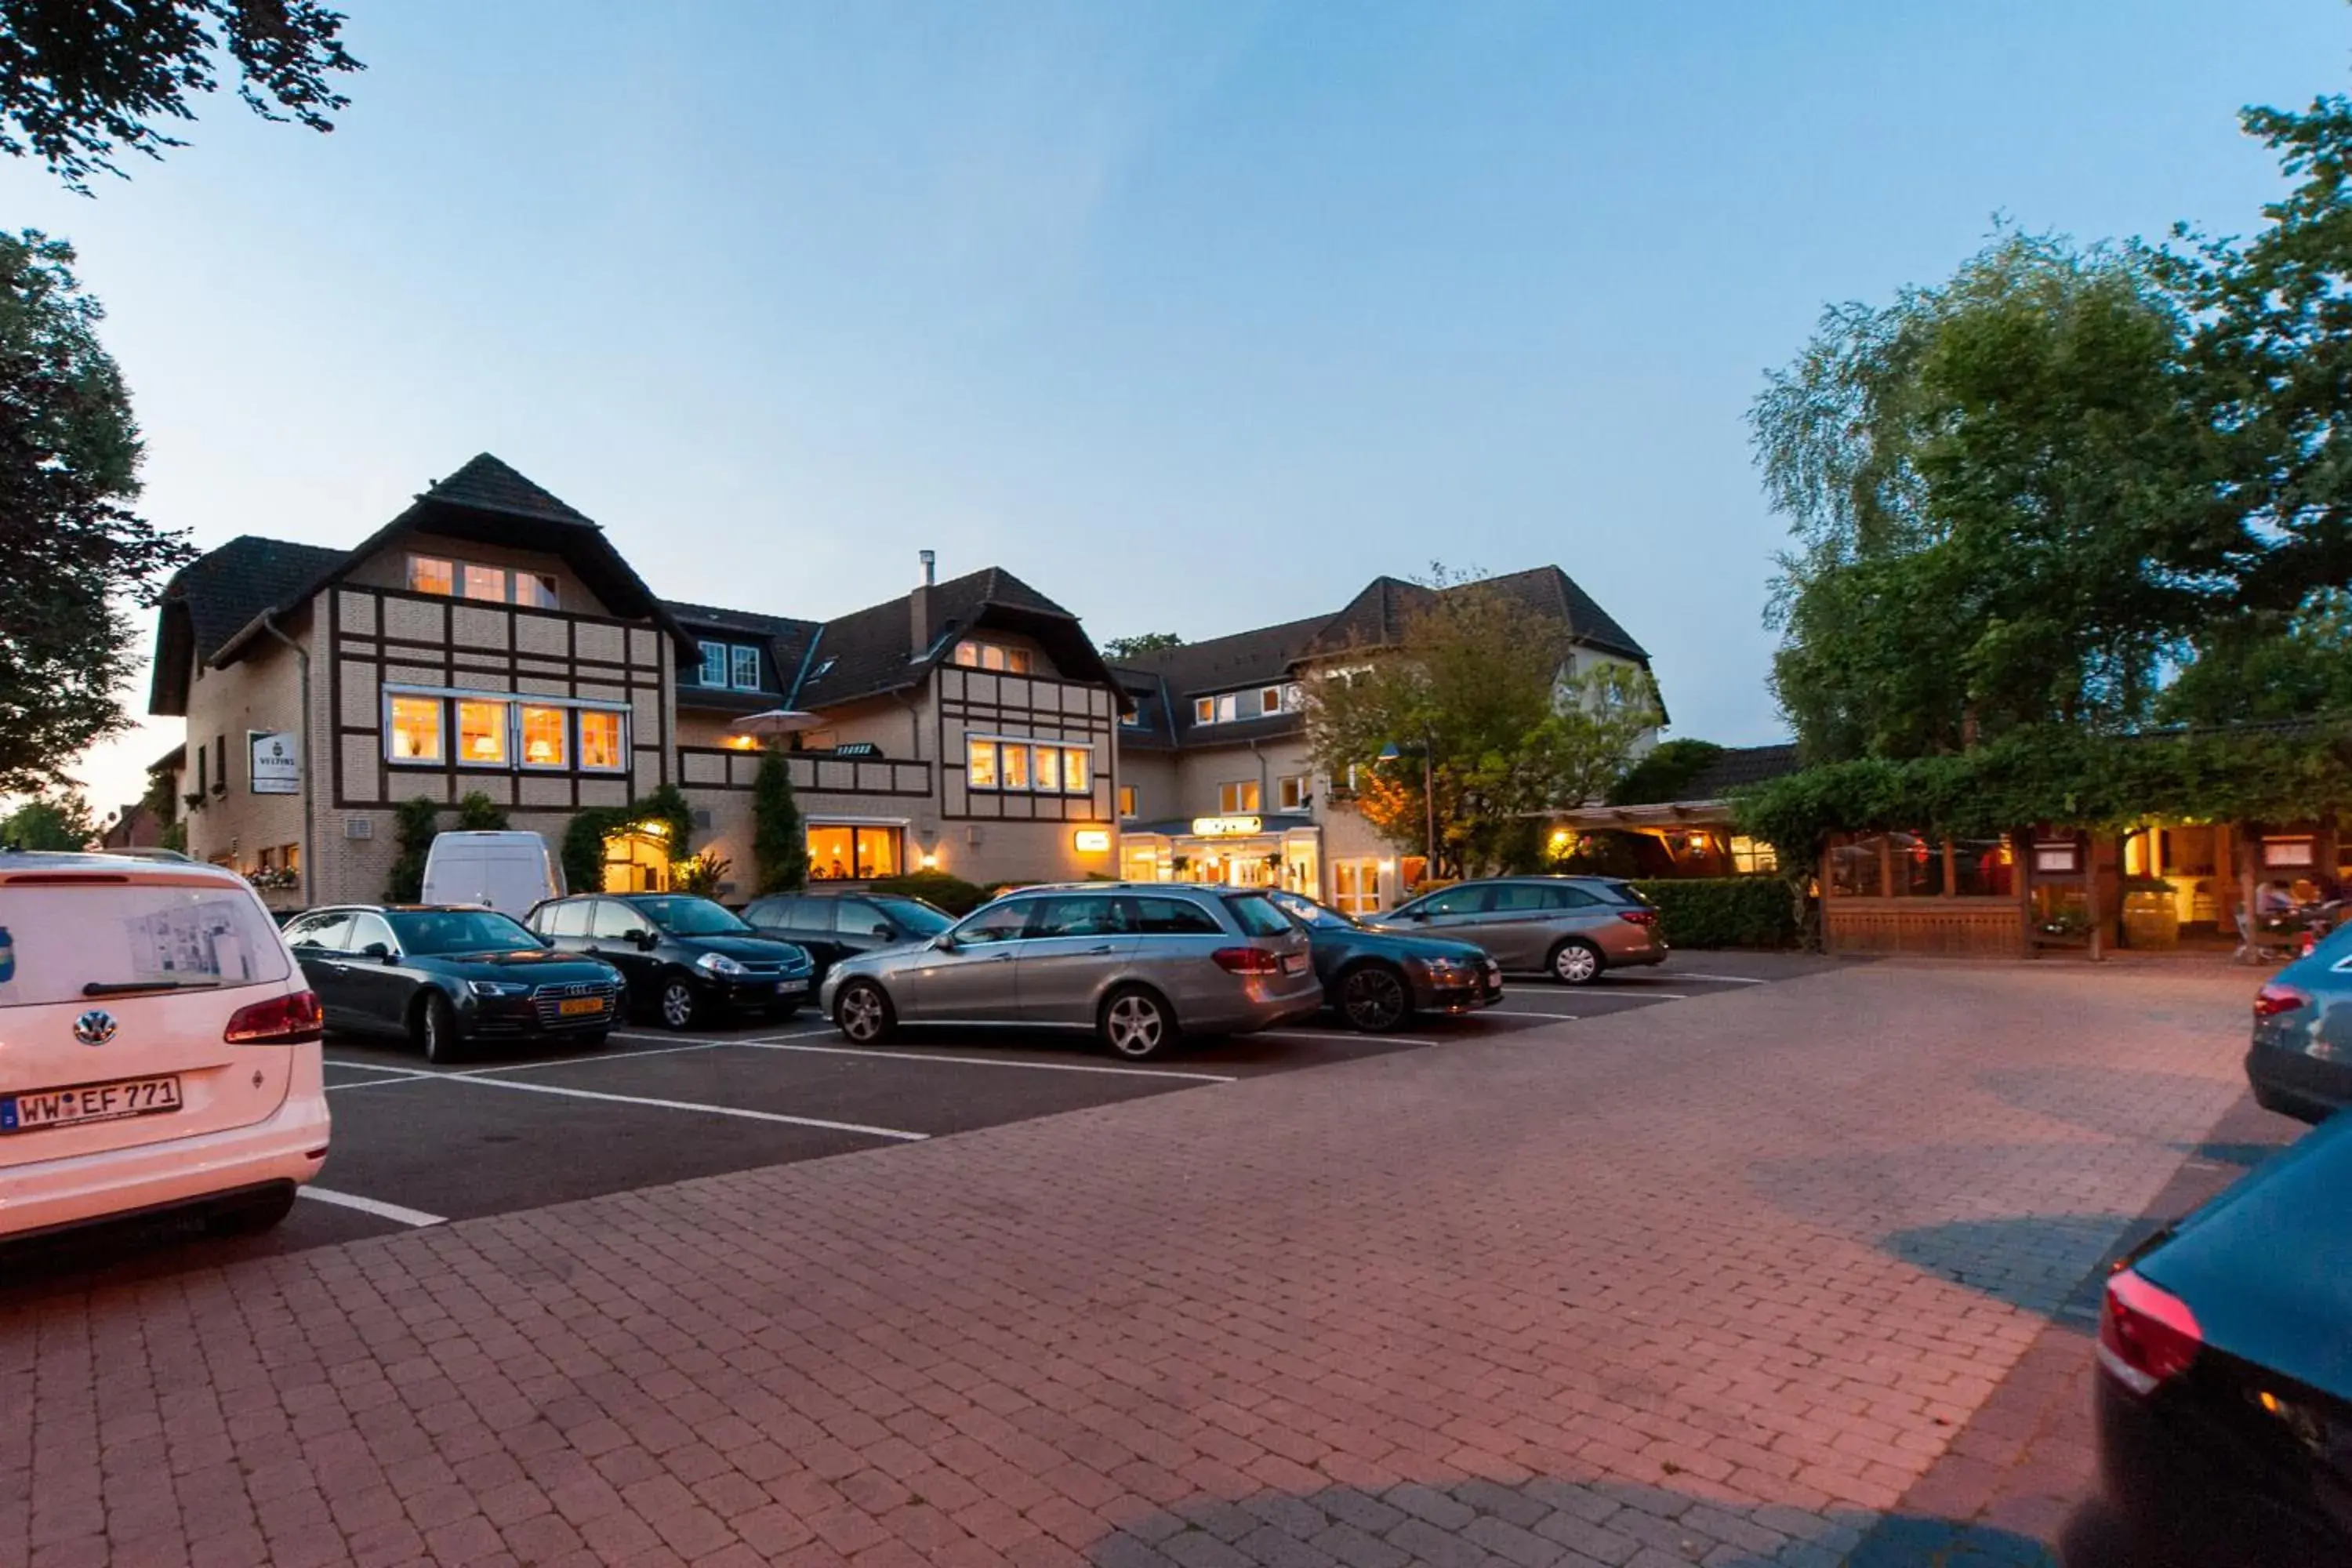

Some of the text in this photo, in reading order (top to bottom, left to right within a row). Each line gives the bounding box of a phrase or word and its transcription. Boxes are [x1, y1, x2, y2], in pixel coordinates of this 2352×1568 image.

[20, 1095, 60, 1123] WW
[81, 1087, 117, 1114] EF
[125, 1081, 176, 1108] 771
